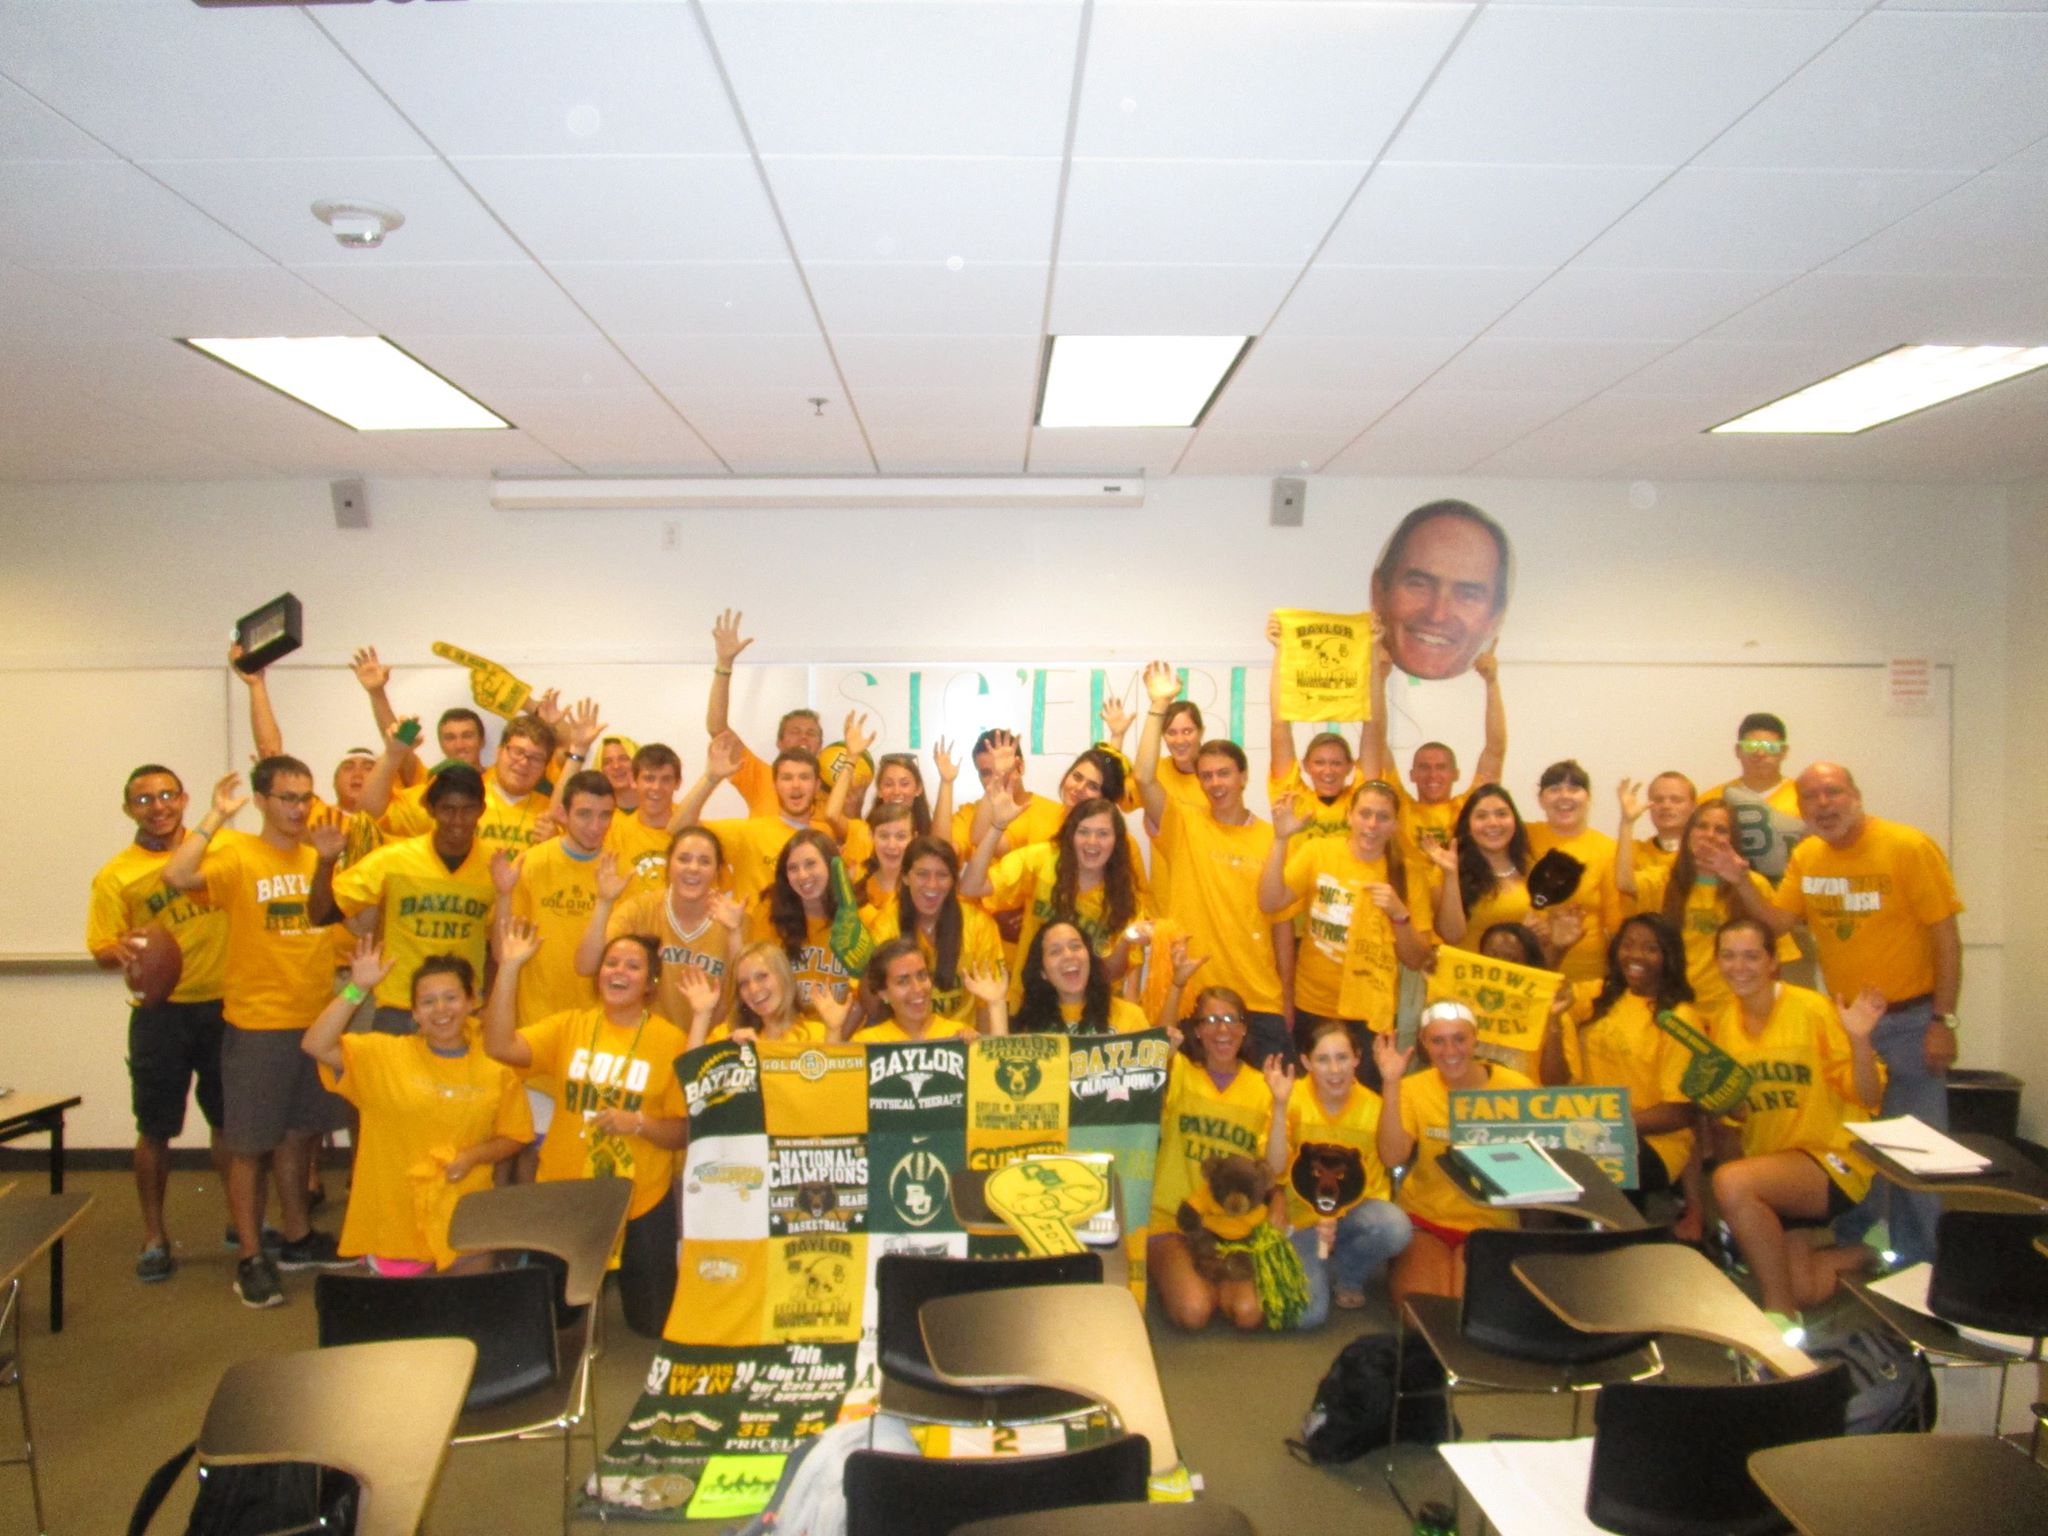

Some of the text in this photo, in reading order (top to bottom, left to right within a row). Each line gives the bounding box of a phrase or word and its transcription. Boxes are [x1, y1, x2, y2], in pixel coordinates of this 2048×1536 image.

[256, 873, 312, 903] BAYL
[414, 918, 472, 939] LINE
[658, 945, 726, 977] AYLOR
[1453, 963, 1538, 999] GROWL
[1474, 1015, 1529, 1035] WEL
[566, 1047, 651, 1093] GOLD
[825, 1056, 866, 1071] RUSH
[868, 1046, 966, 1087] BAYLOR
[1069, 1037, 1171, 1081] BAYLOR
[684, 1067, 758, 1105] BAYLOR
[868, 1093, 963, 1111] PHYSICAL THERAPY
[1453, 1092, 1624, 1122] FAN CAVE
[768, 1157, 868, 1188] CHAMPIONS
[777, 1148, 853, 1170] NATIONAL
[787, 1220, 849, 1234] BASKETBALL
[991, 1427, 1021, 1452] 2
